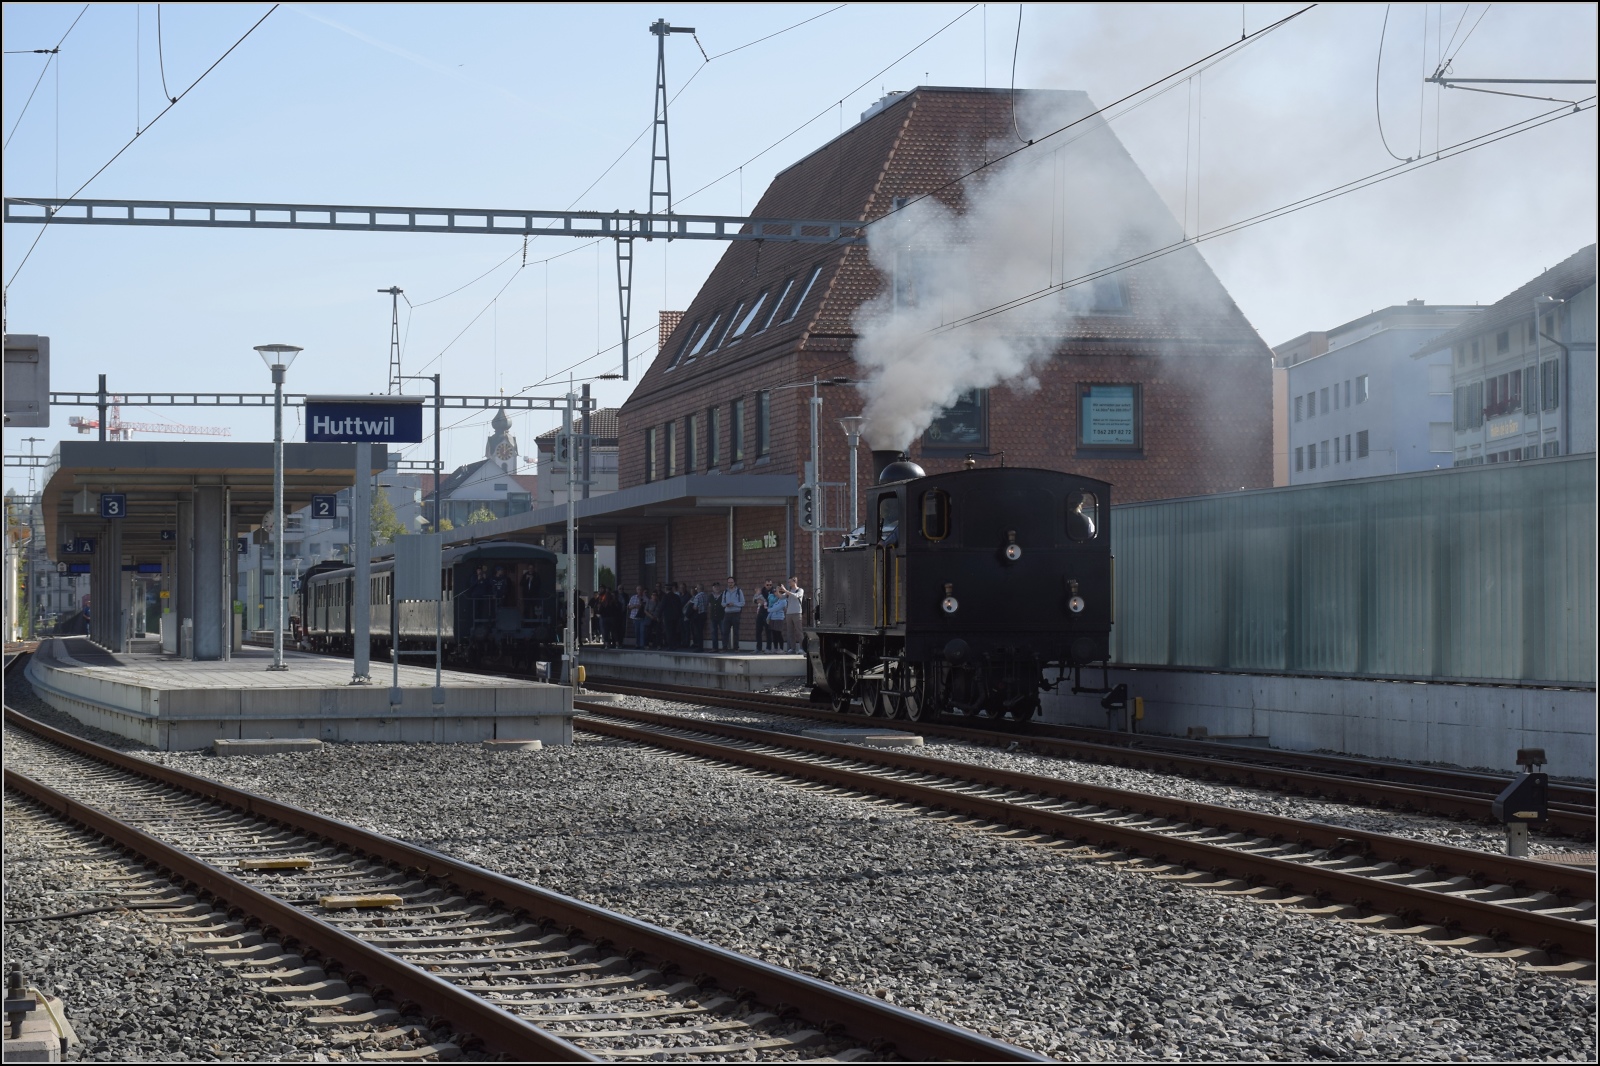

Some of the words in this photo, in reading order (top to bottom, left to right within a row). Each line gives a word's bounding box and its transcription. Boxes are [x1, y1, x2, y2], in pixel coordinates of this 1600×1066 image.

[313, 415, 395, 436] Huttwil
[108, 501, 119, 515] 3
[319, 502, 329, 515] 2
[66, 543, 74, 552] 3
[83, 542, 91, 552] A
[237, 542, 243, 552] 2
[582, 543, 590, 552] A
